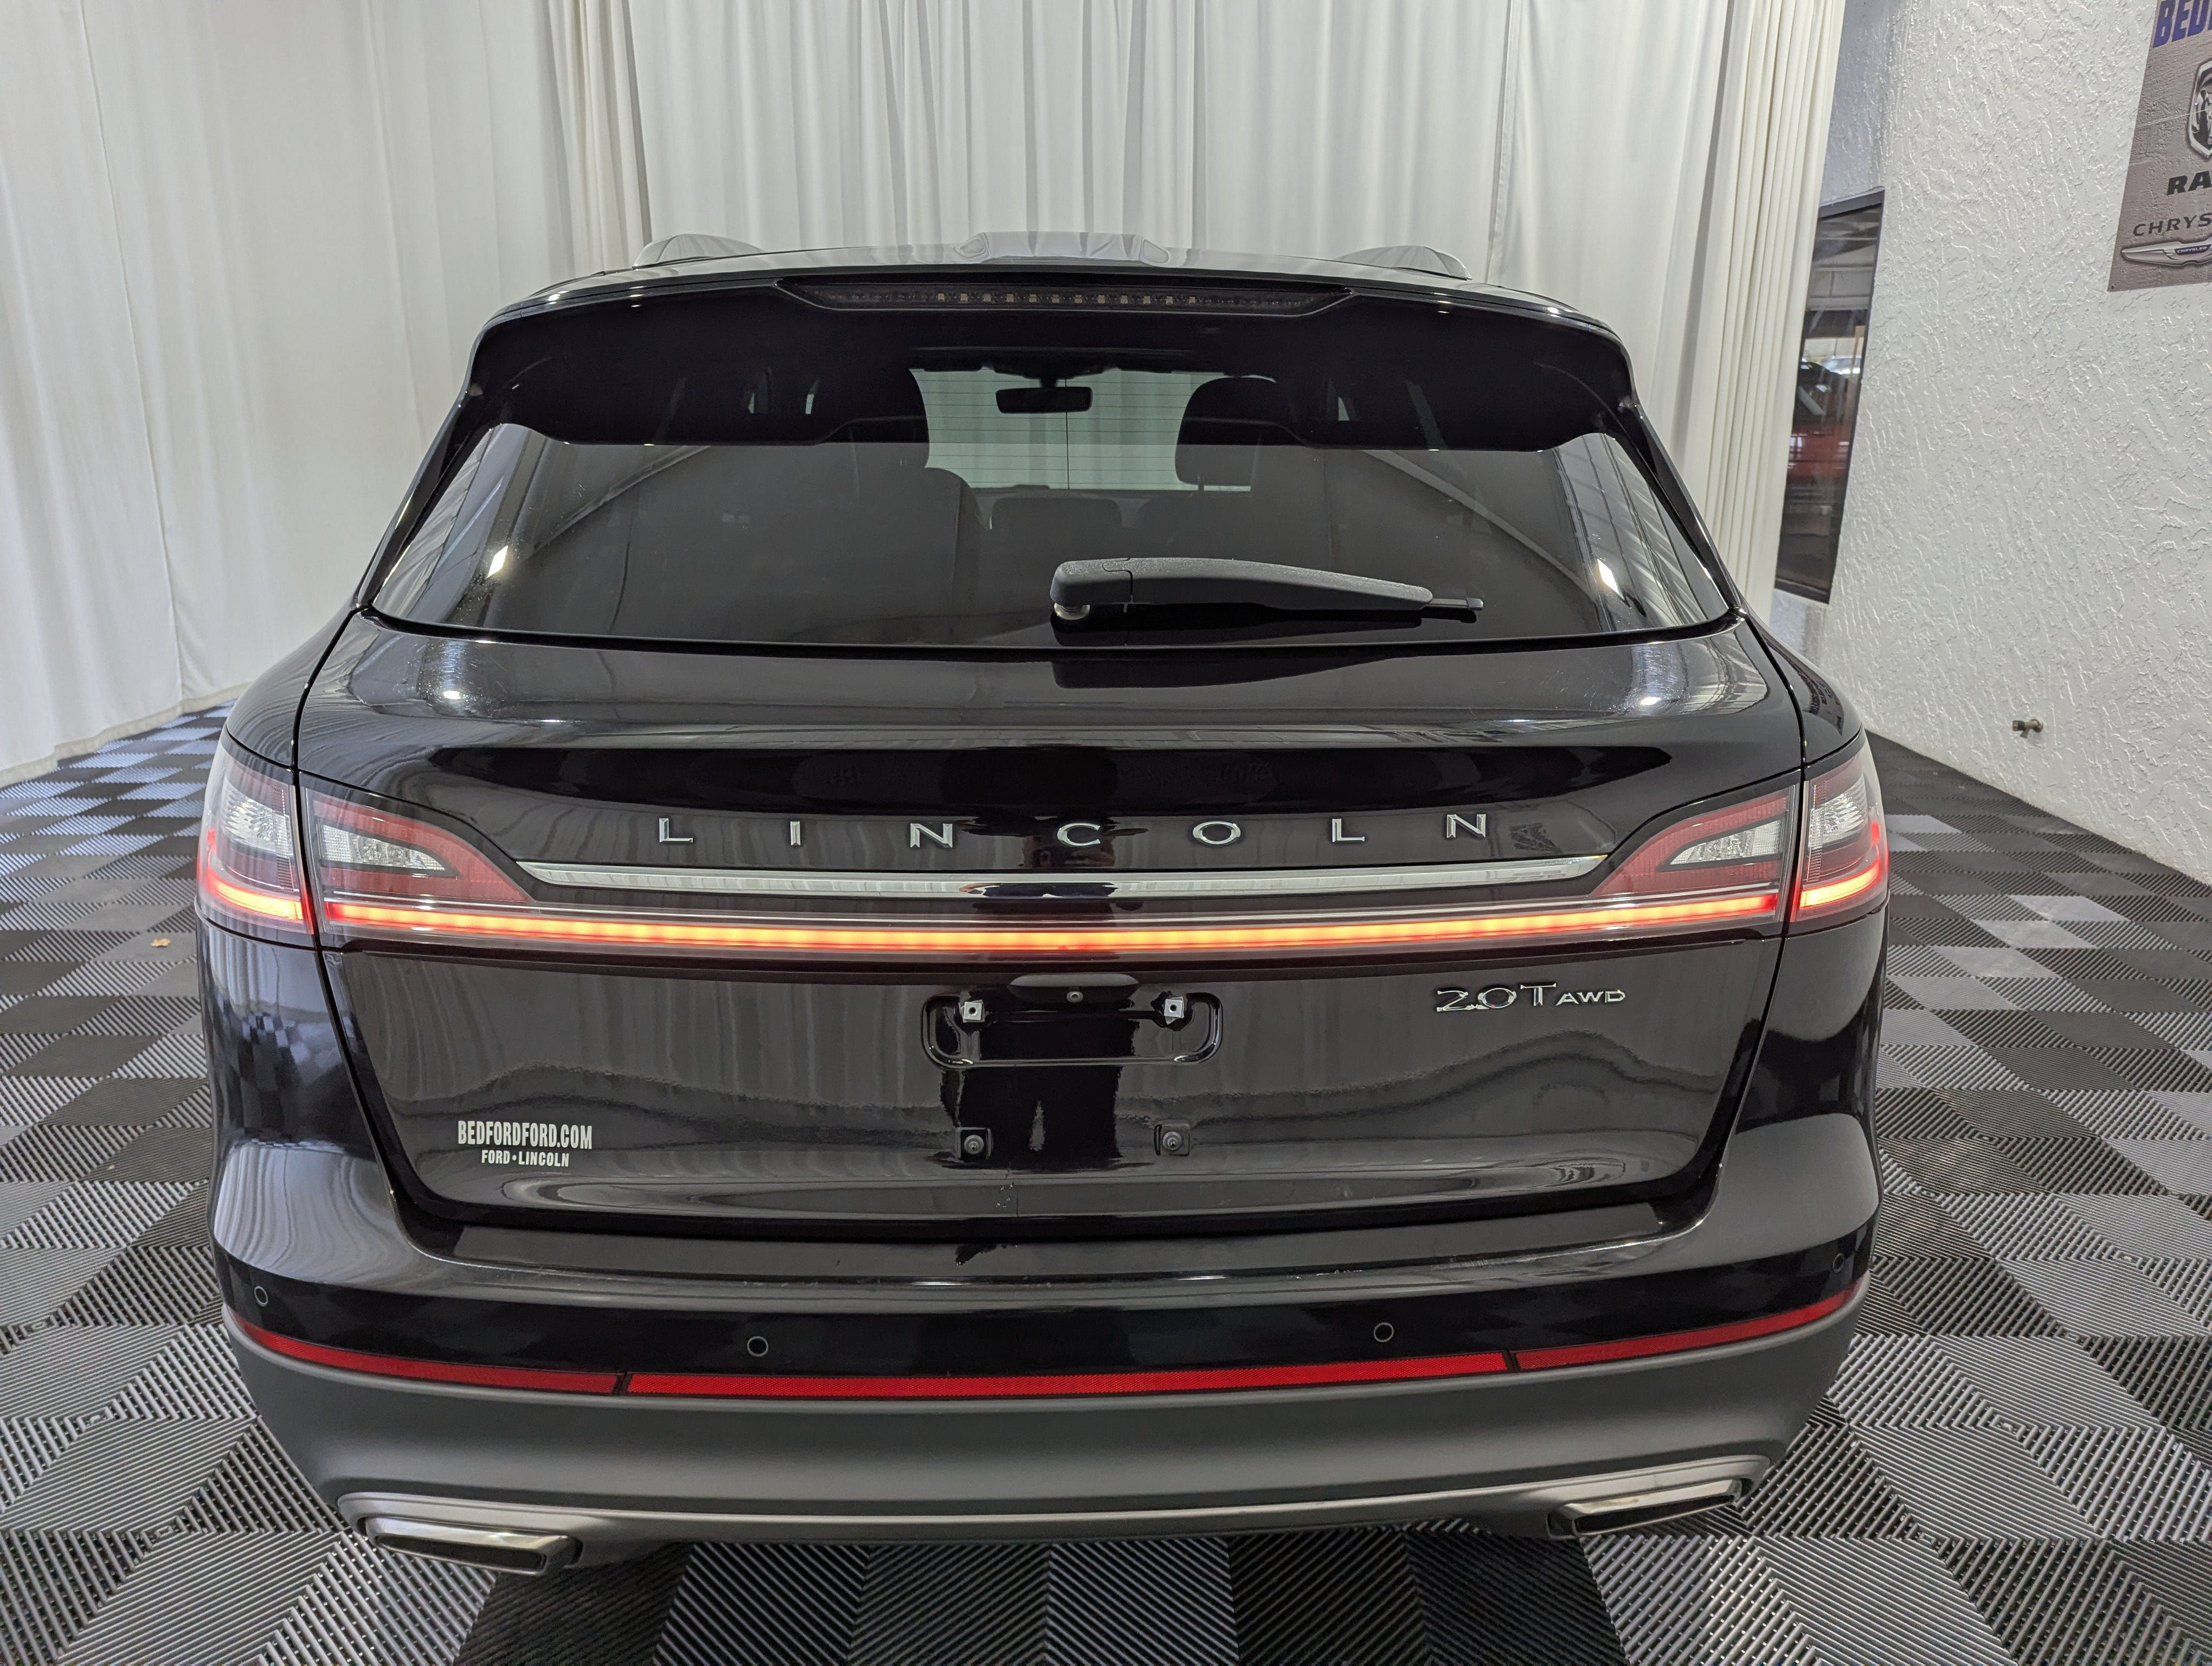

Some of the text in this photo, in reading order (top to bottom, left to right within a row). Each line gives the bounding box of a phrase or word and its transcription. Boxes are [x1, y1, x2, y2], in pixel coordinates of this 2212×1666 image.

[2133, 212, 2212, 236] CHRYS
[658, 814, 1486, 849] LINCOLN
[1555, 990, 1626, 1006] AWD
[458, 1120, 593, 1149] BEDFORDFORD.COM
